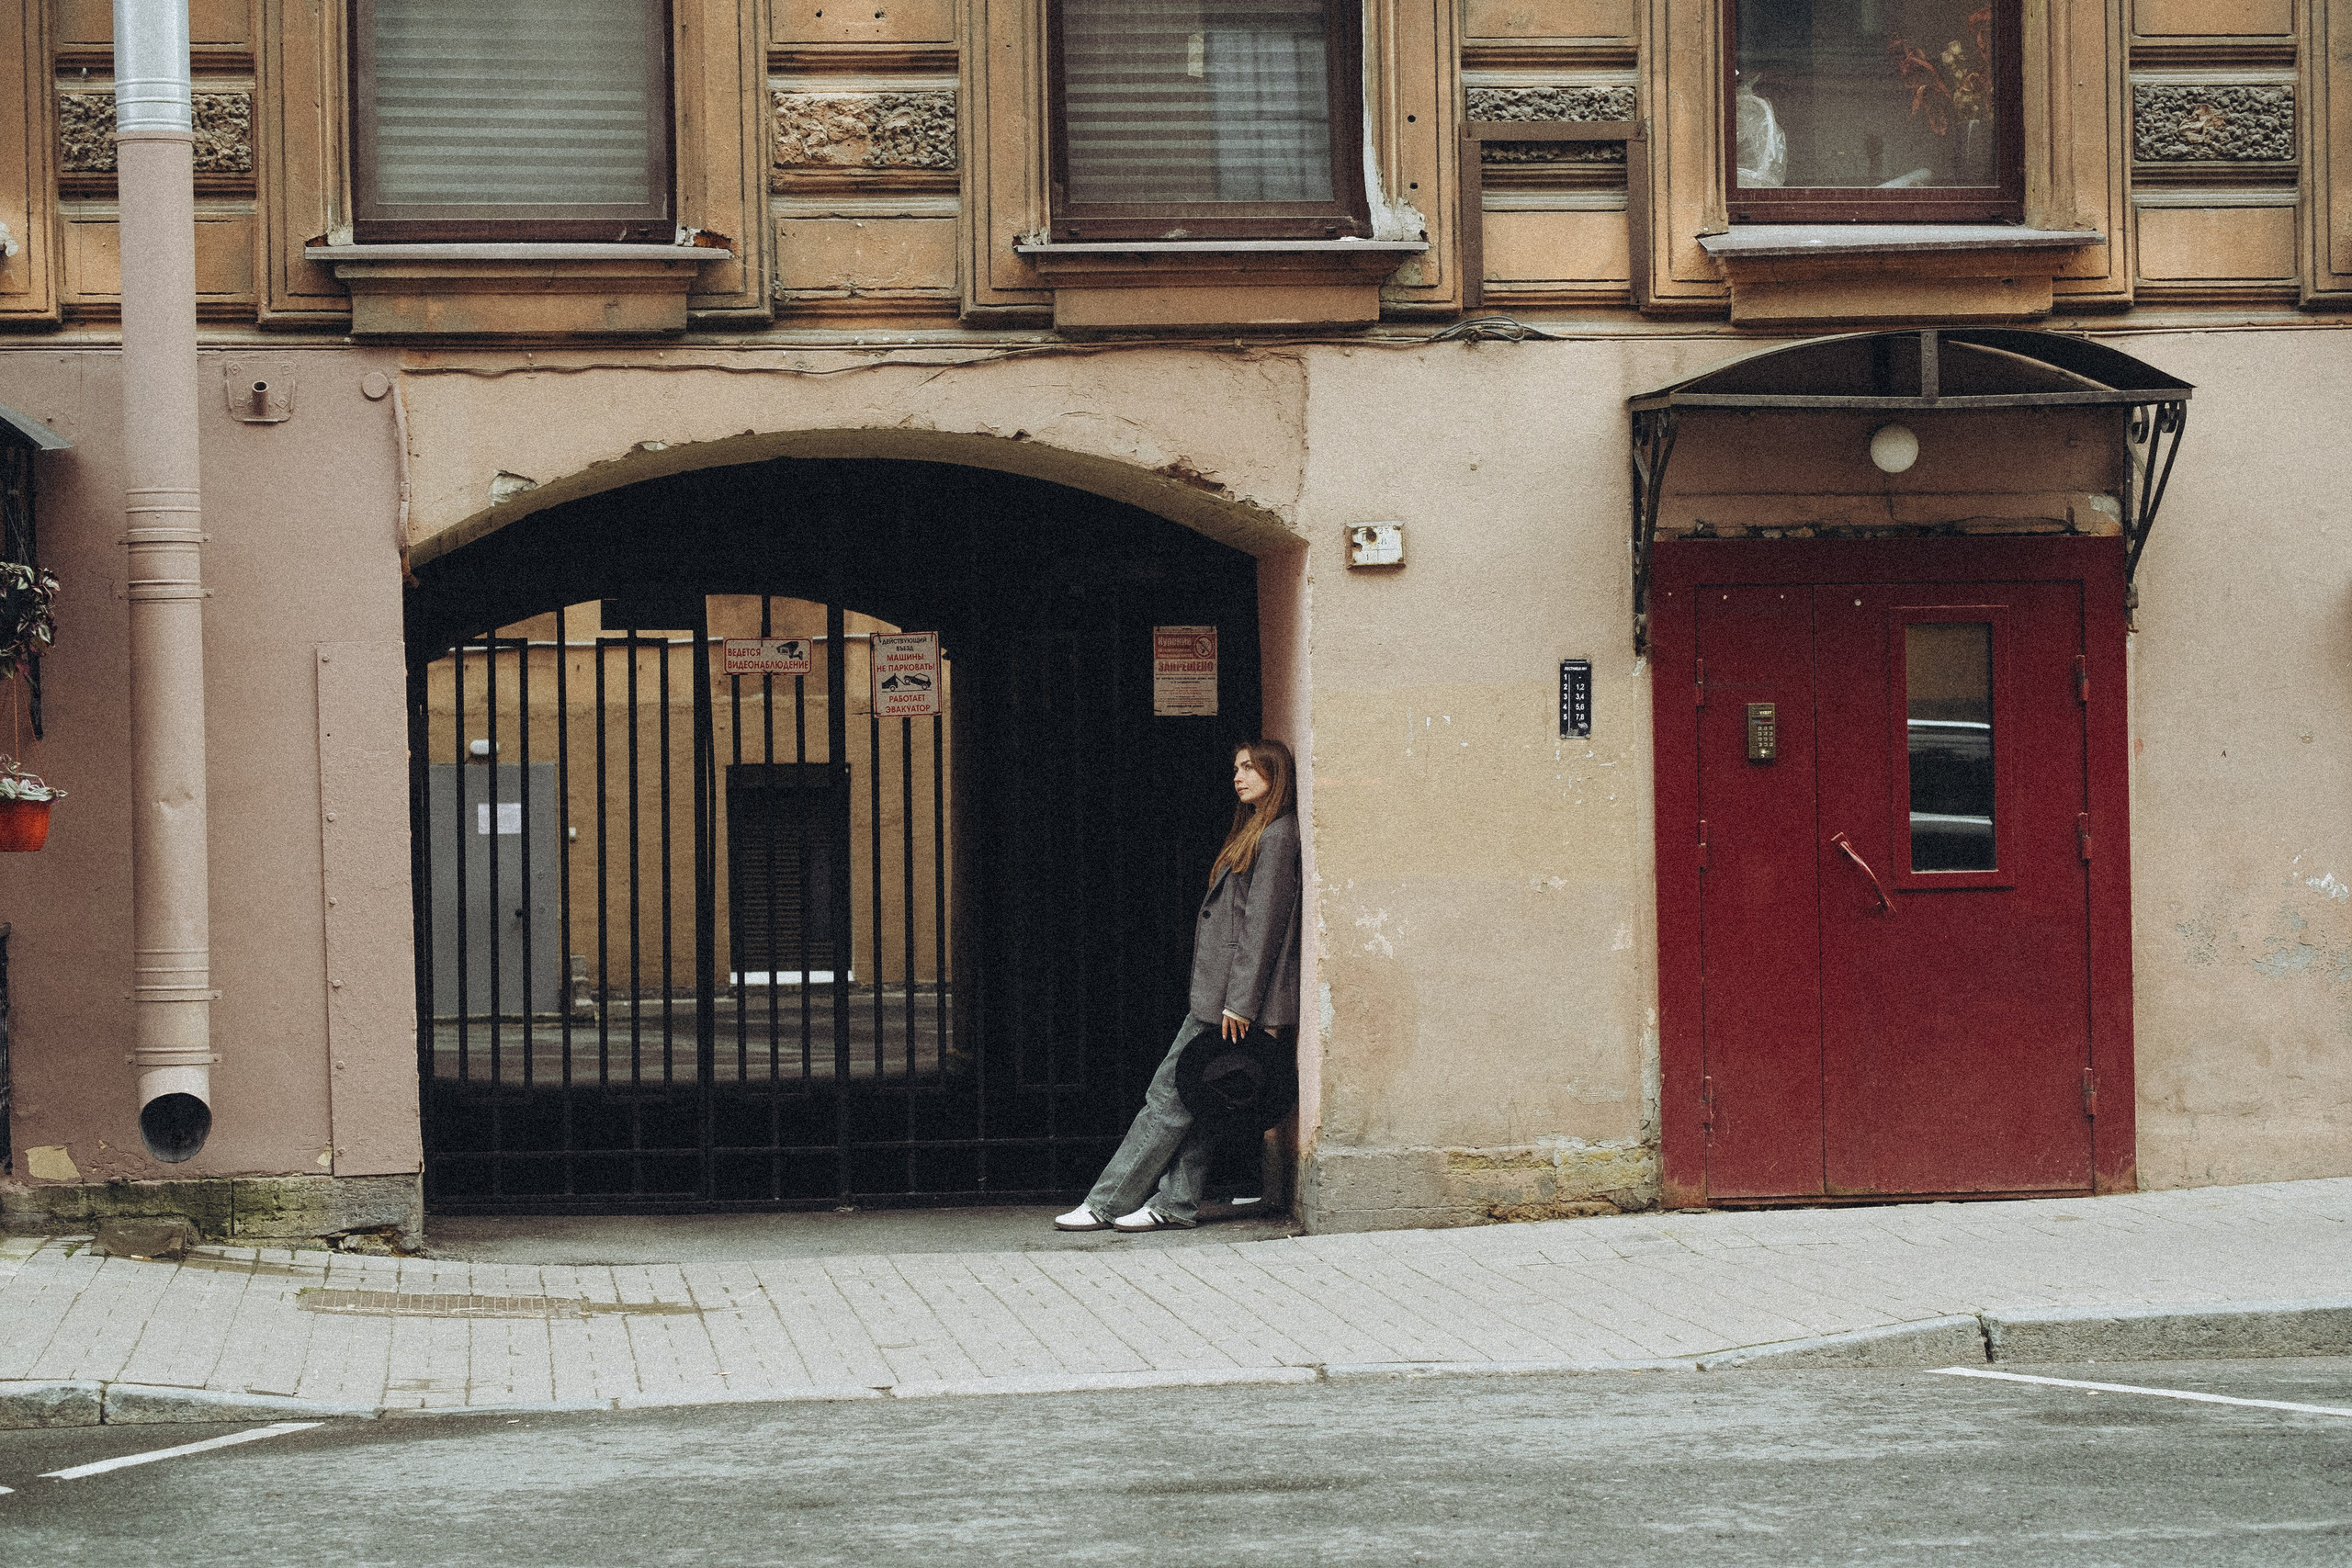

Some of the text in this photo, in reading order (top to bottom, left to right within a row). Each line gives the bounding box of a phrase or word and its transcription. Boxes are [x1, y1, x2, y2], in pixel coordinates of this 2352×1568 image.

[882, 637, 927, 645] ДЕЙСТВУЮЩИЙ
[728, 648, 761, 658] ВЕДЕТСЯ
[887, 653, 924, 661] МАШИНЫ
[728, 660, 808, 670] ВИДЕОНАБЛЮДЕНИЕ
[876, 663, 935, 672] НЕ ПАРКОВАТЬ!
[1158, 660, 1214, 672] ЗАПРЕЩЕНО
[888, 694, 925, 703] РАБОТАЕТ
[1575, 693, 1585, 701] 3,4
[886, 705, 931, 713] ЭВАКУАТОР
[1575, 703, 1585, 711] 5,6
[1575, 713, 1585, 721] 7,8
